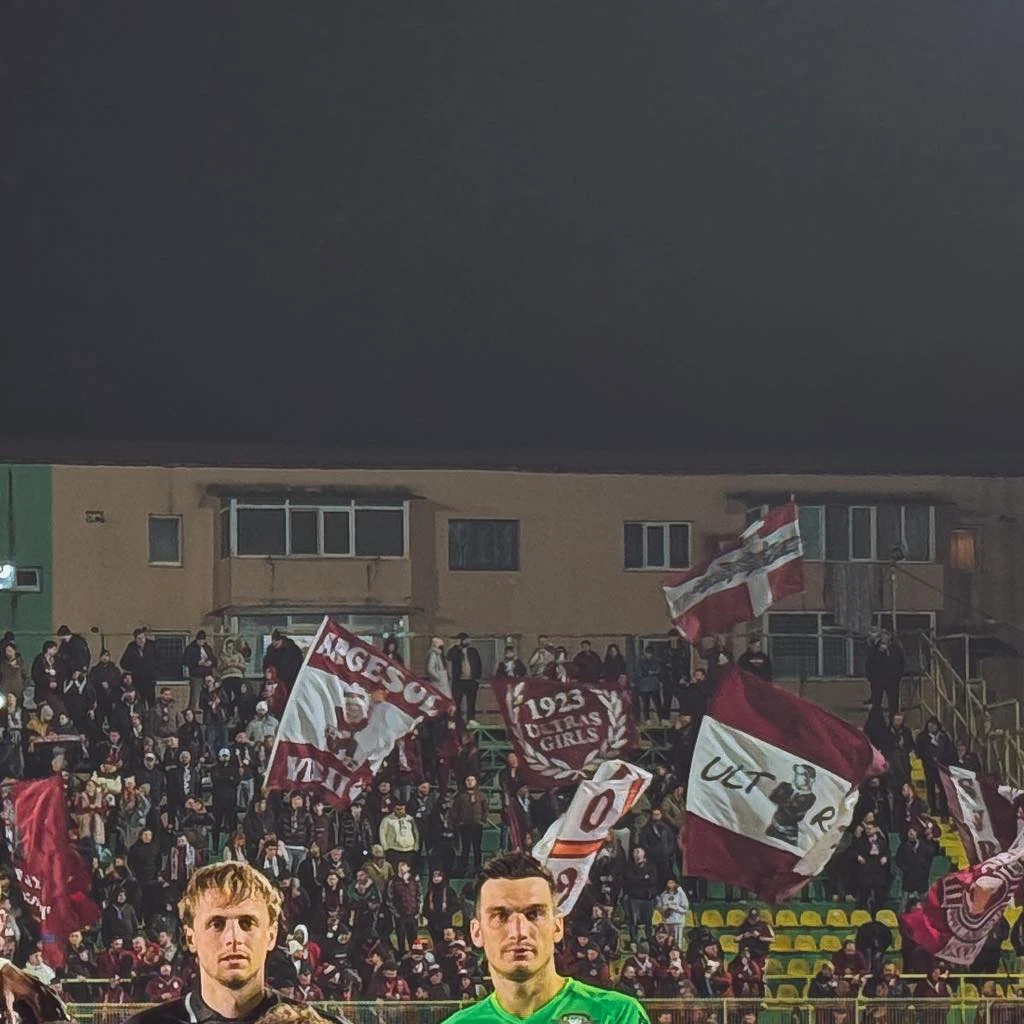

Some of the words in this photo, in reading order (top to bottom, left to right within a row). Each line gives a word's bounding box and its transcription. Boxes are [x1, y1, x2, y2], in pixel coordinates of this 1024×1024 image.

[526, 689, 585, 720] 1923
[525, 711, 602, 739] ULTRAS
[540, 727, 600, 751] GIRLS
